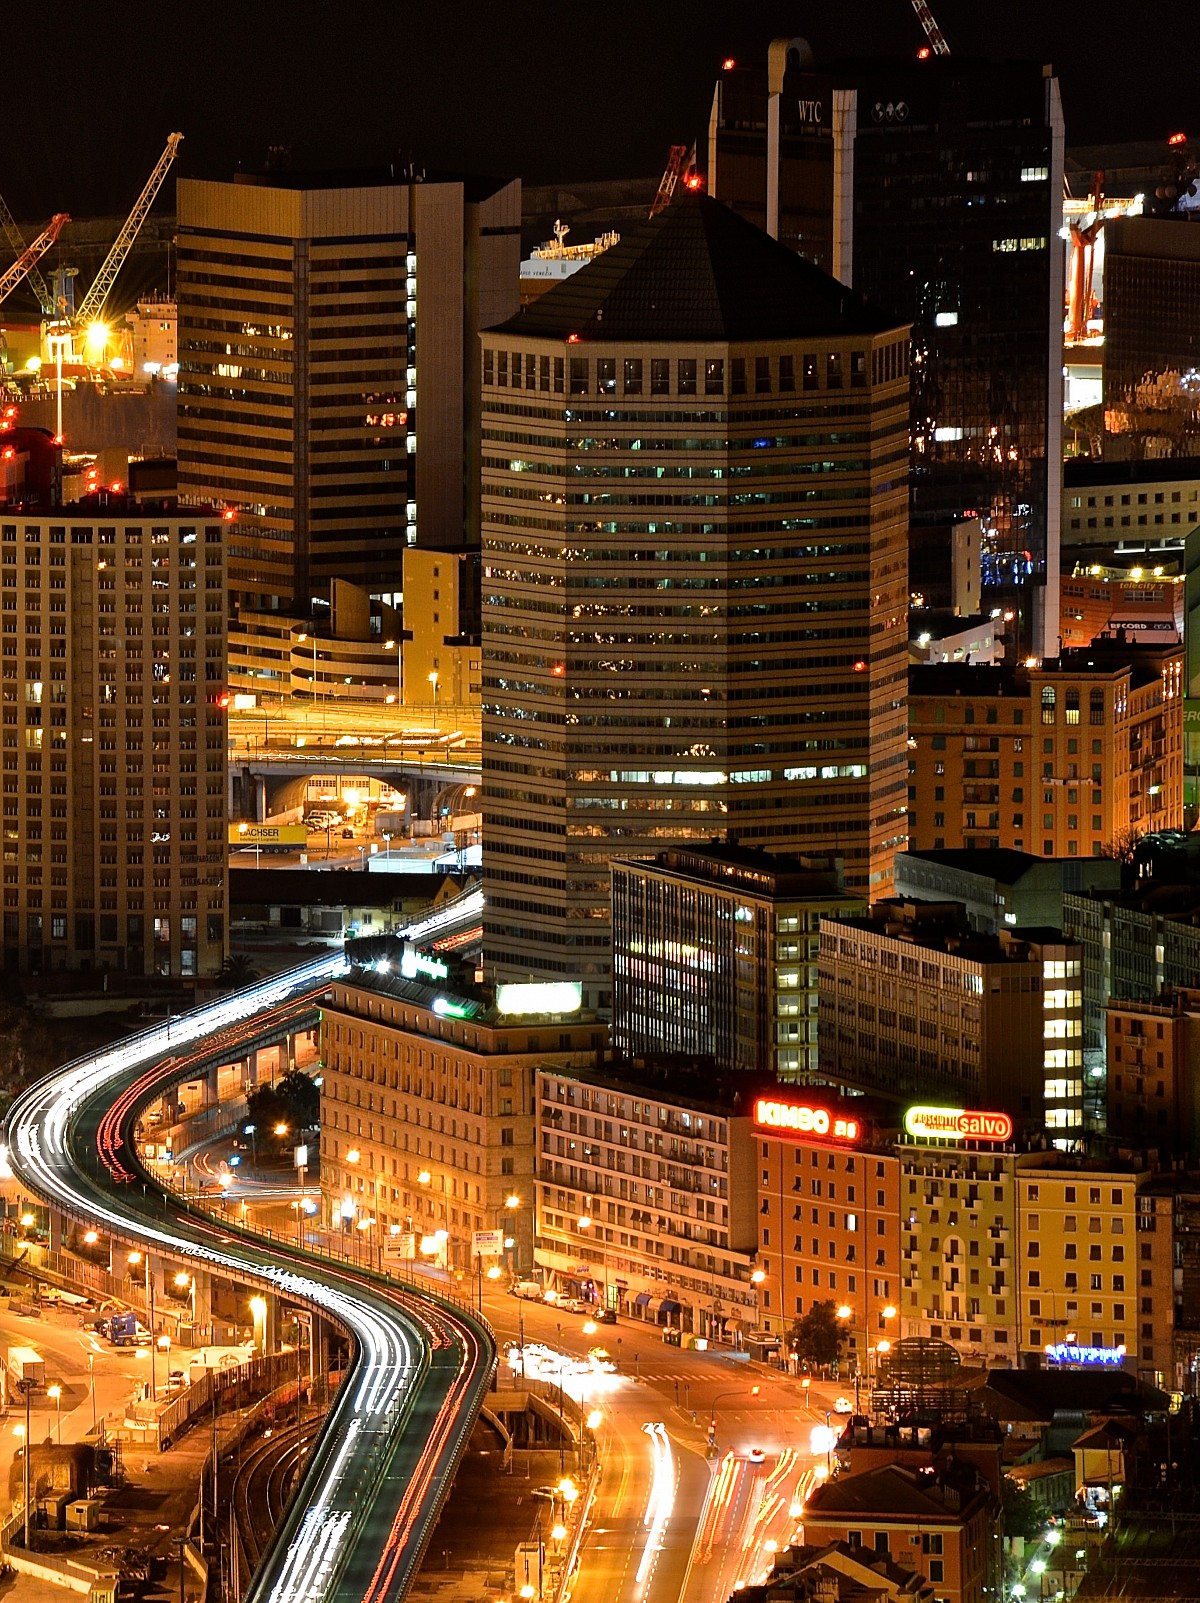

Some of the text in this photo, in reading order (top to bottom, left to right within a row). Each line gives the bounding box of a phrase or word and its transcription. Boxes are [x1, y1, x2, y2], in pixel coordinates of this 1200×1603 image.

[798, 100, 822, 123] WTC
[1120, 582, 1156, 590] telecity
[240, 828, 279, 837] DACHSER
[757, 1100, 830, 1134] KIMBO
[912, 1113, 957, 1126] PROSCIUTTI
[960, 1116, 1006, 1135] salvo
